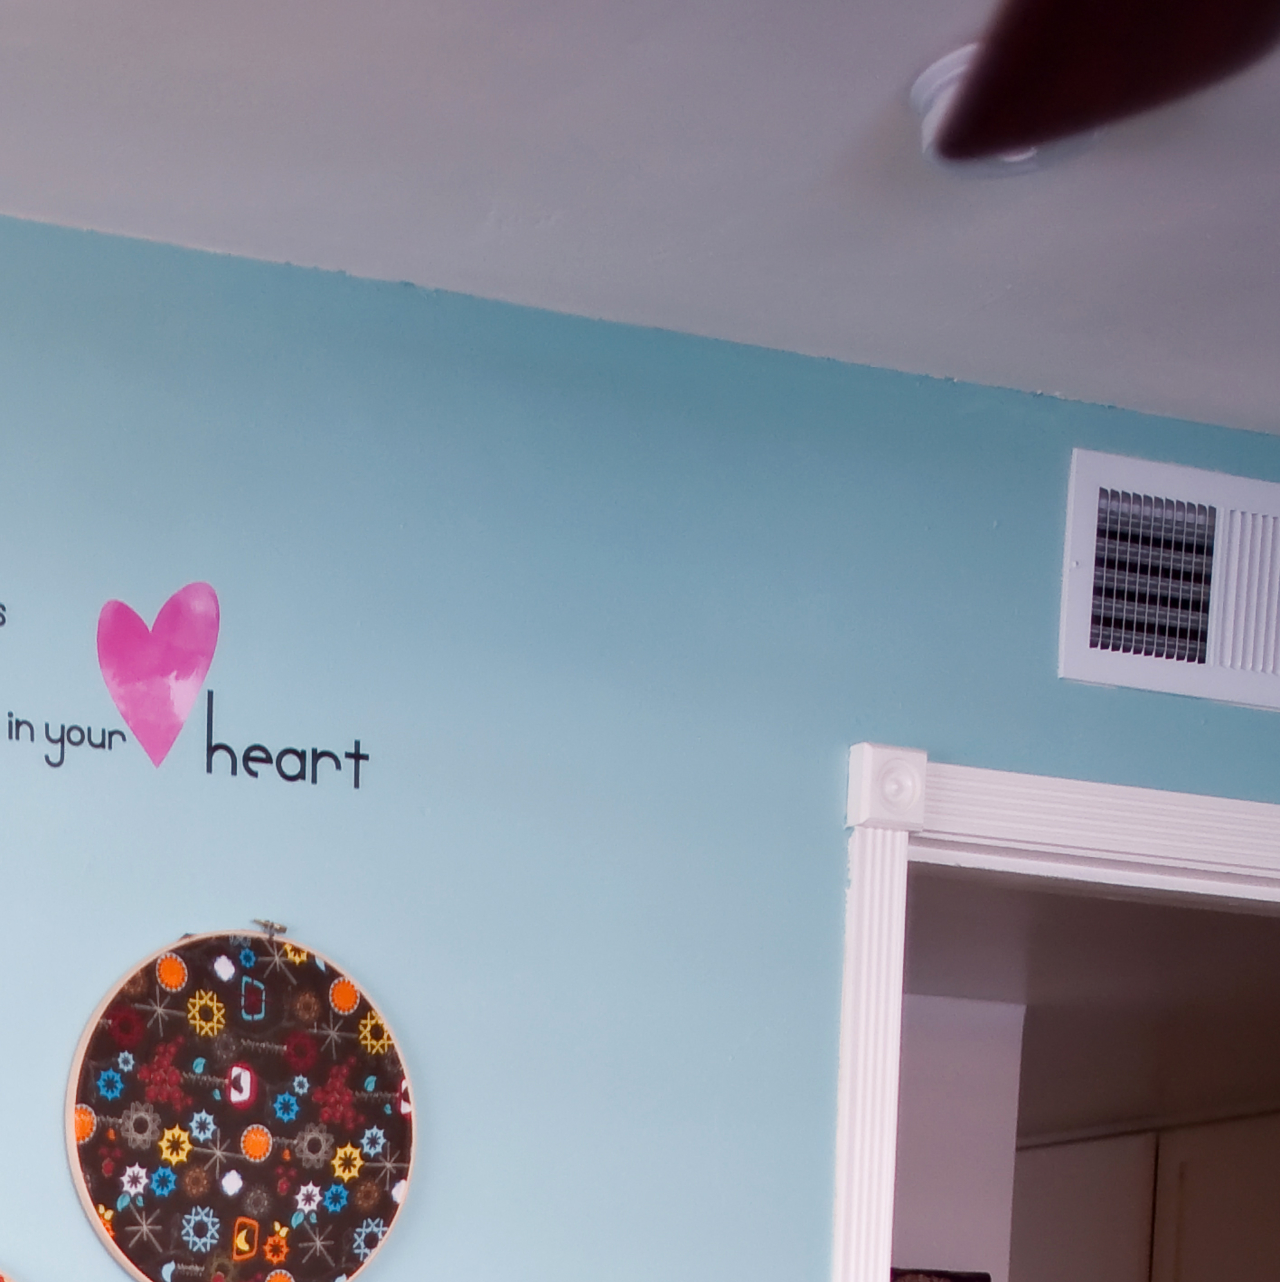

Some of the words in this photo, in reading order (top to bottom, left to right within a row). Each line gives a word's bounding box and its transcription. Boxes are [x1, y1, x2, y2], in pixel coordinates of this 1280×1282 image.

[5, 709, 36, 744] in
[43, 720, 128, 770] your
[204, 688, 371, 791] heart
